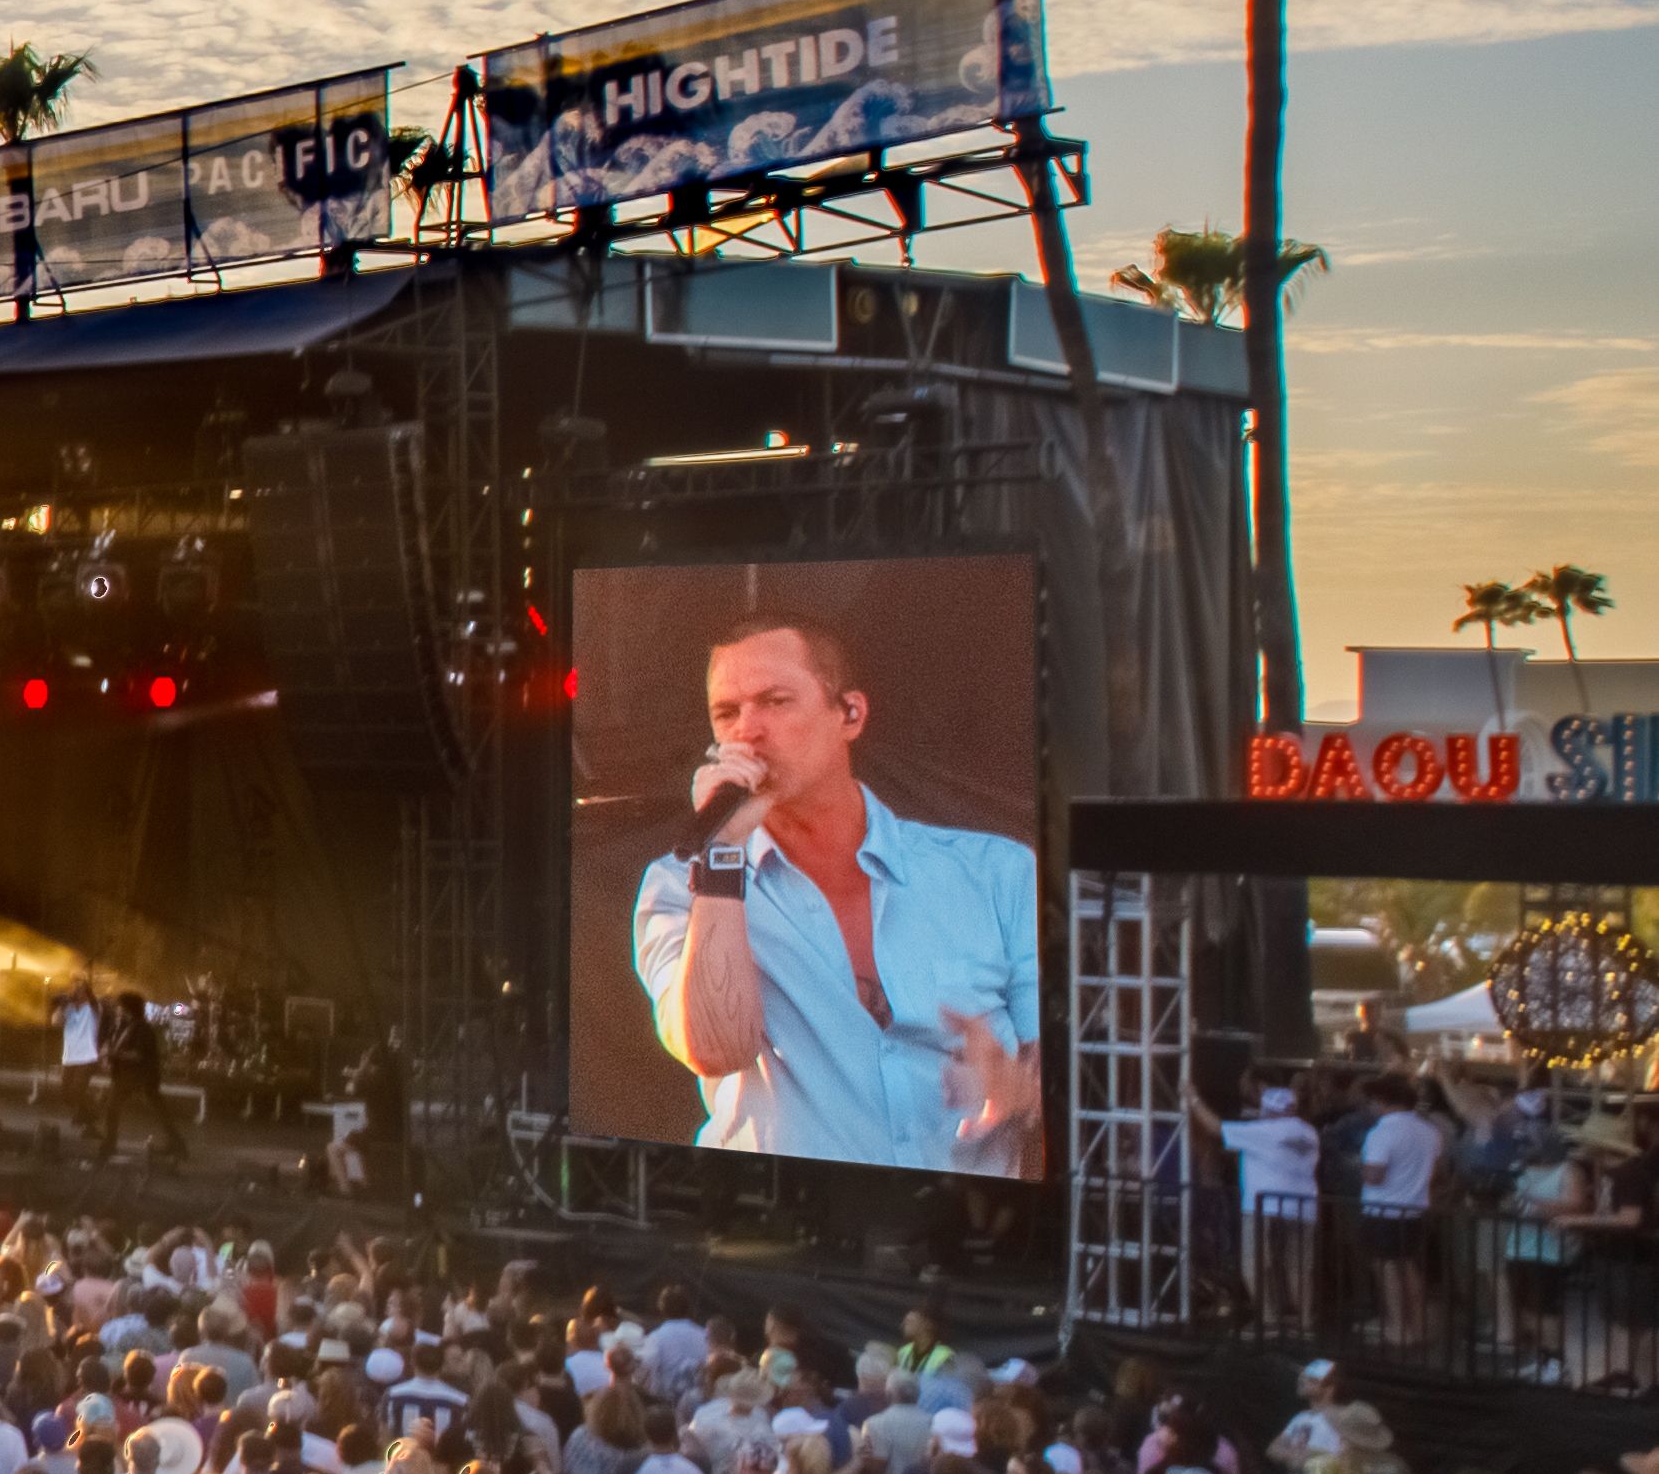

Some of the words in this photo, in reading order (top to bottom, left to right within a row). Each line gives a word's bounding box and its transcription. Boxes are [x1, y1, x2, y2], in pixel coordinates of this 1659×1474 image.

[605, 15, 899, 125] HIGHTIDE
[183, 130, 371, 201] PACIFIC
[1248, 732, 1520, 801] DAOU
[1546, 713, 1659, 802] SI
